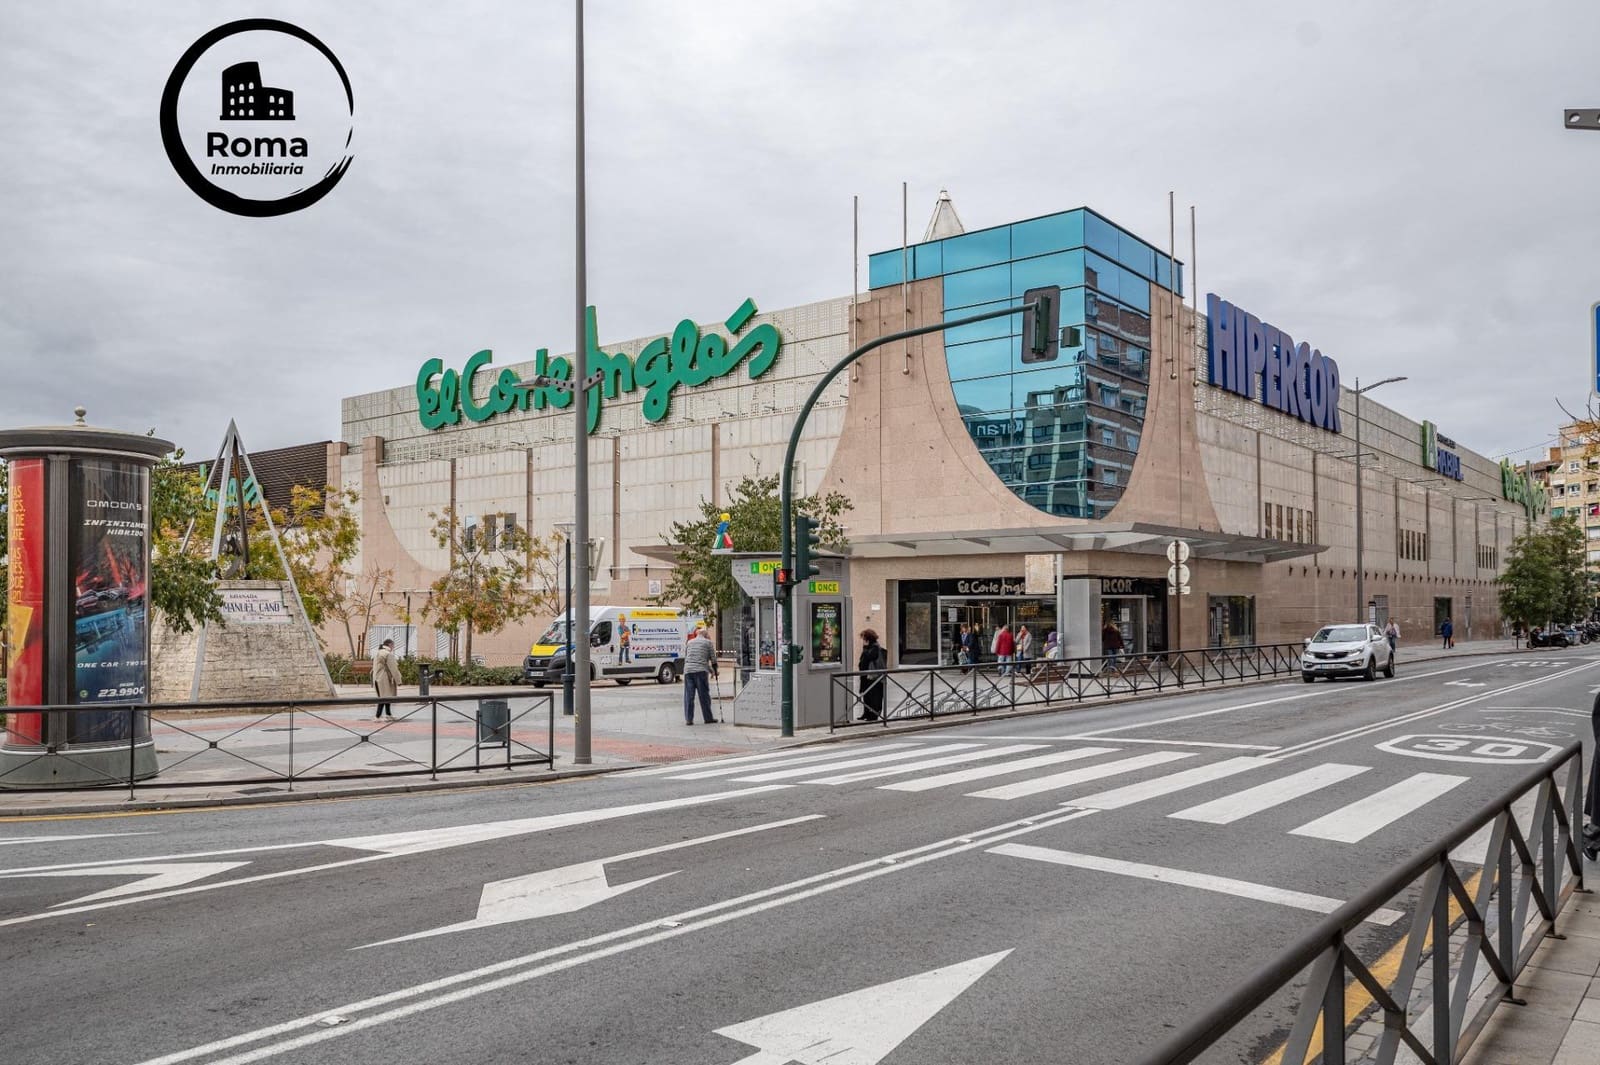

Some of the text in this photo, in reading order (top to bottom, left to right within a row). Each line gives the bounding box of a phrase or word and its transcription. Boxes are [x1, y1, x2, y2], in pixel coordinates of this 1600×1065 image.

[1206, 293, 1341, 433] HIPERCOR
[416, 358, 461, 430] El
[461, 349, 574, 422] Corte
[762, 563, 782, 571] ONC
[817, 583, 837, 591] ONCE
[957, 577, 1026, 597] El Corte Ingl
[1102, 580, 1132, 593] RCOR
[223, 602, 280, 612] MANUEL CANO
[1413, 739, 1529, 757] 30
